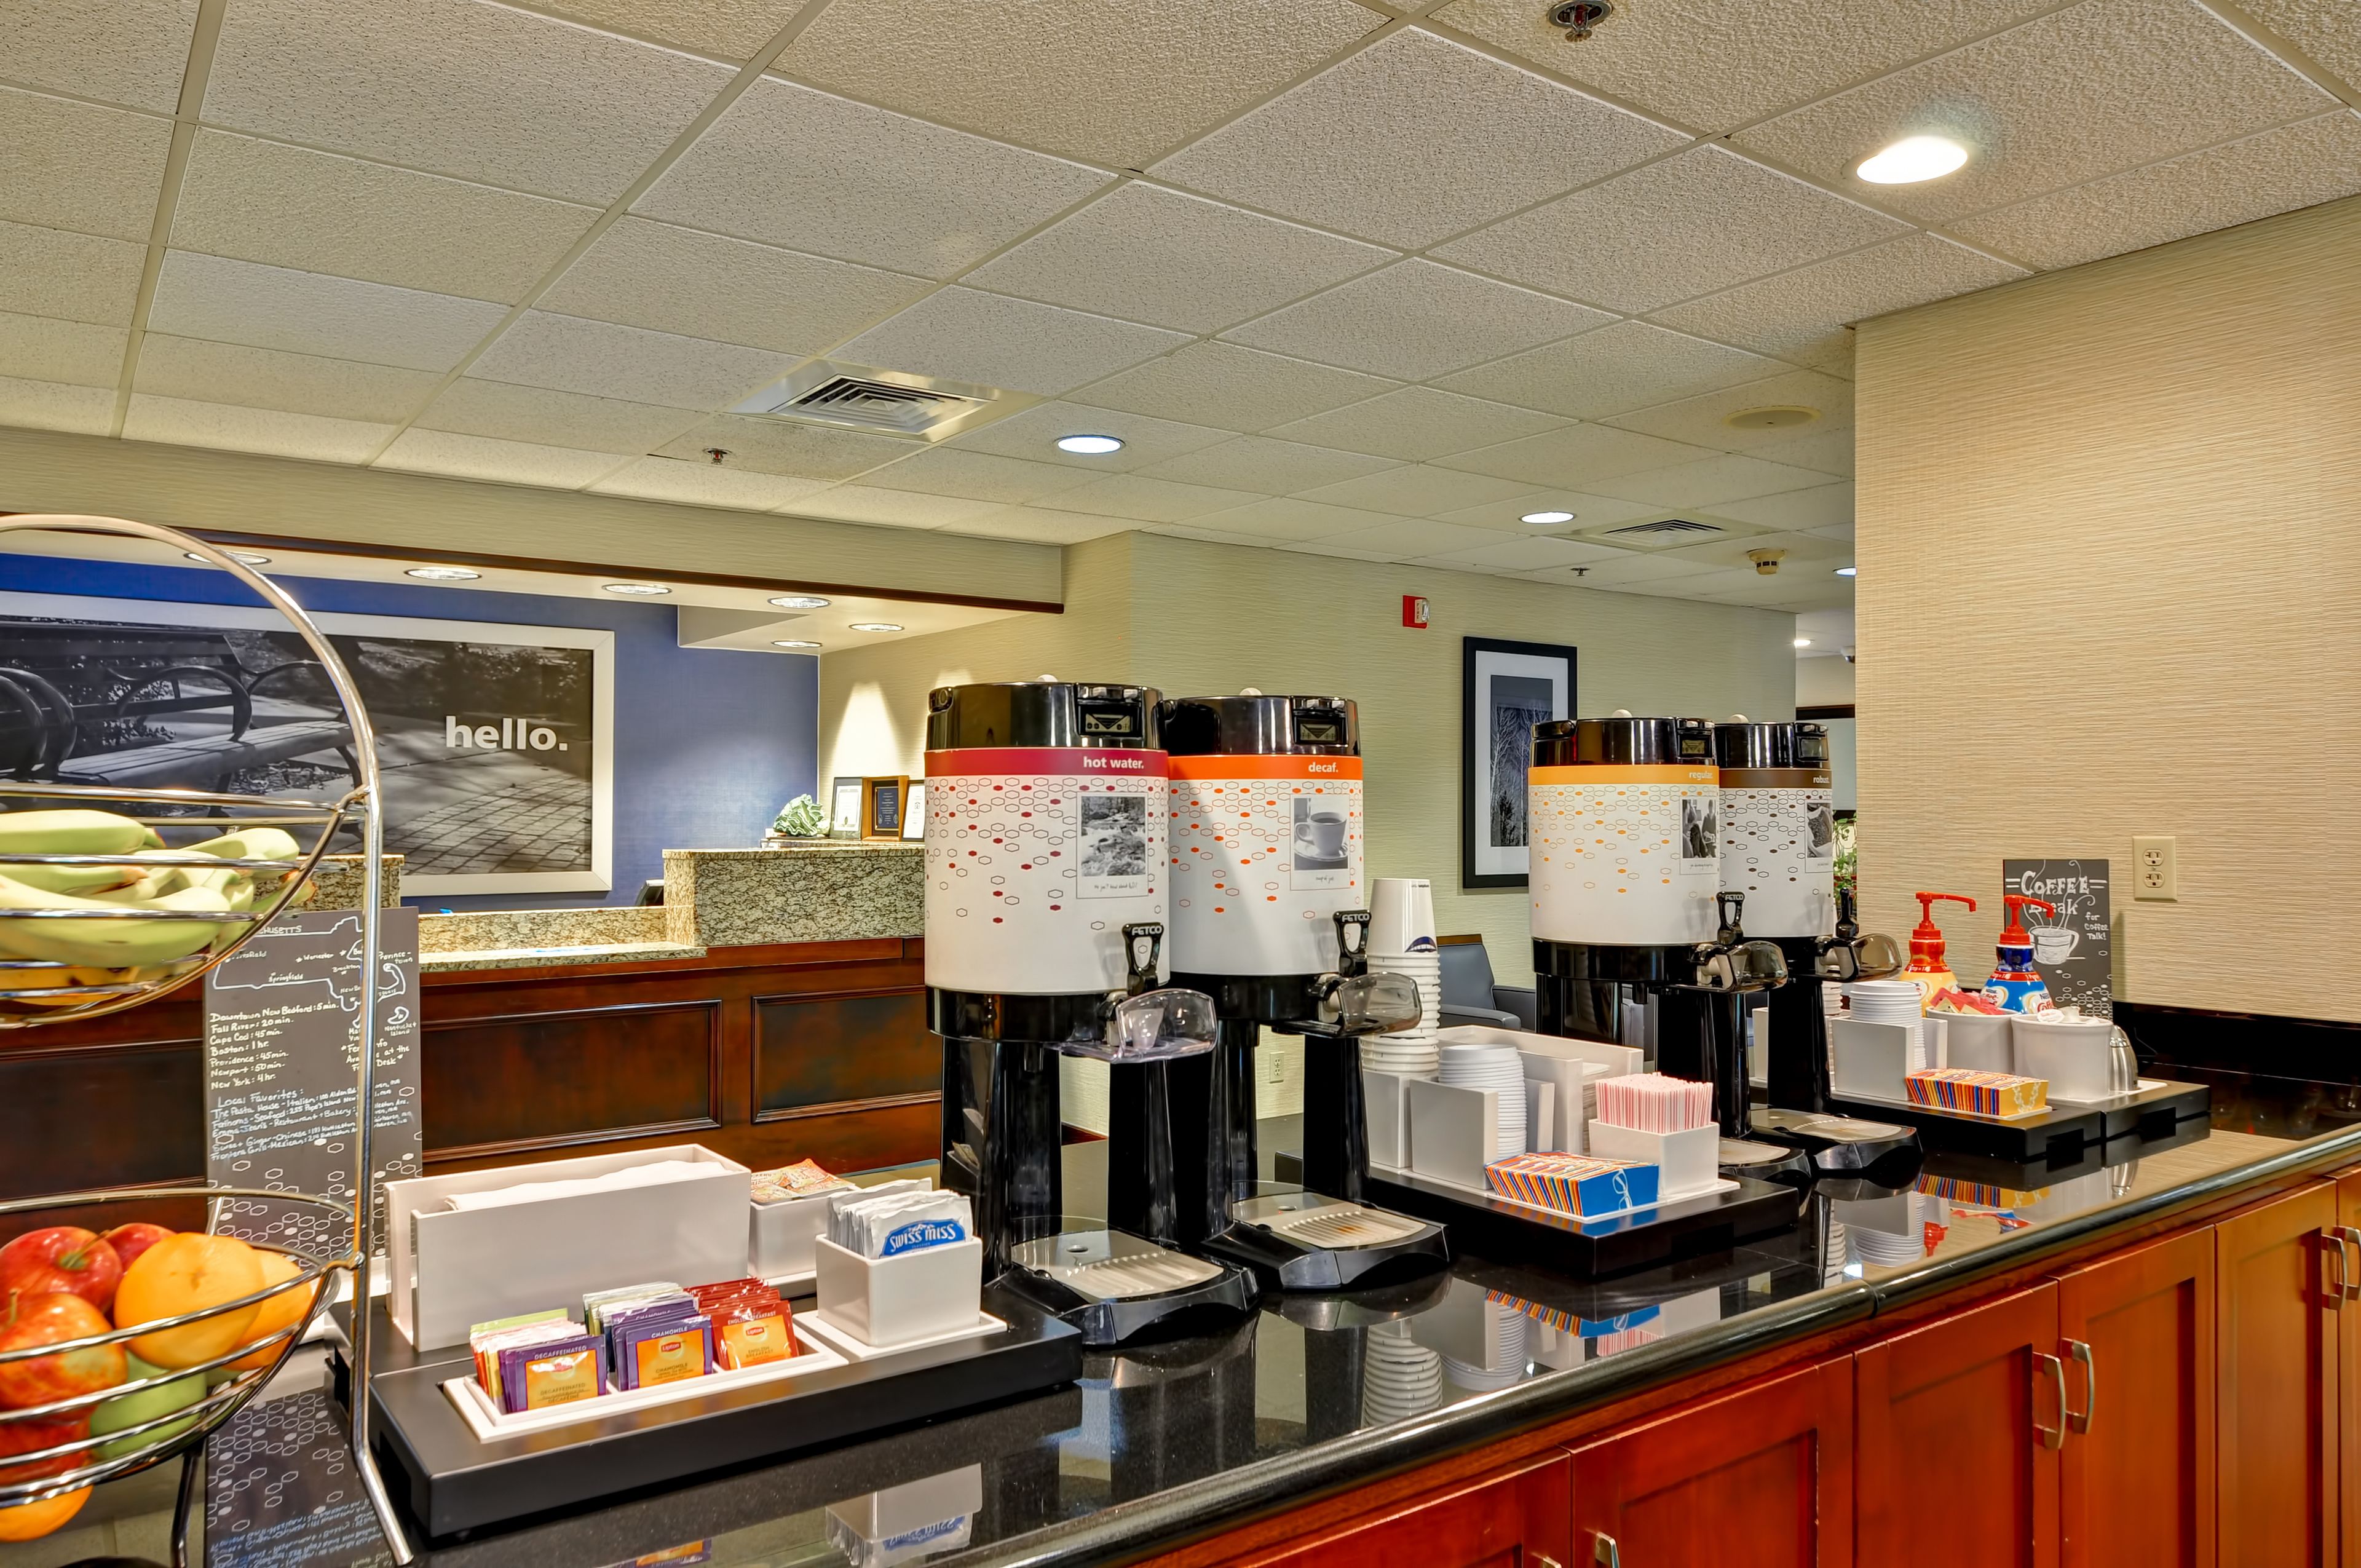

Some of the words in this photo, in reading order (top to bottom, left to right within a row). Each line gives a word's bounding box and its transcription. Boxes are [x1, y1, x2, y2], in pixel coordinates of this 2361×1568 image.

[446, 715, 568, 751] hello.
[1083, 756, 1107, 768] hot
[1110, 758, 1144, 769] water.
[1308, 761, 1339, 773] decaf.
[1342, 913, 1370, 922] FETCO
[2085, 911, 2100, 921] for
[1131, 925, 1163, 936] FETCO
[2084, 923, 2110, 932] Coffee
[2086, 932, 2107, 941] Talk!
[211, 1023, 229, 1034] Fall
[211, 1081, 231, 1090] New
[218, 1096, 246, 1108] Local
[889, 1230, 922, 1253] SWISS
[651, 1326, 688, 1339] CHAMOMILE
[534, 1345, 587, 1360] DECAFFEINATED
[662, 1342, 680, 1352] Lipton
